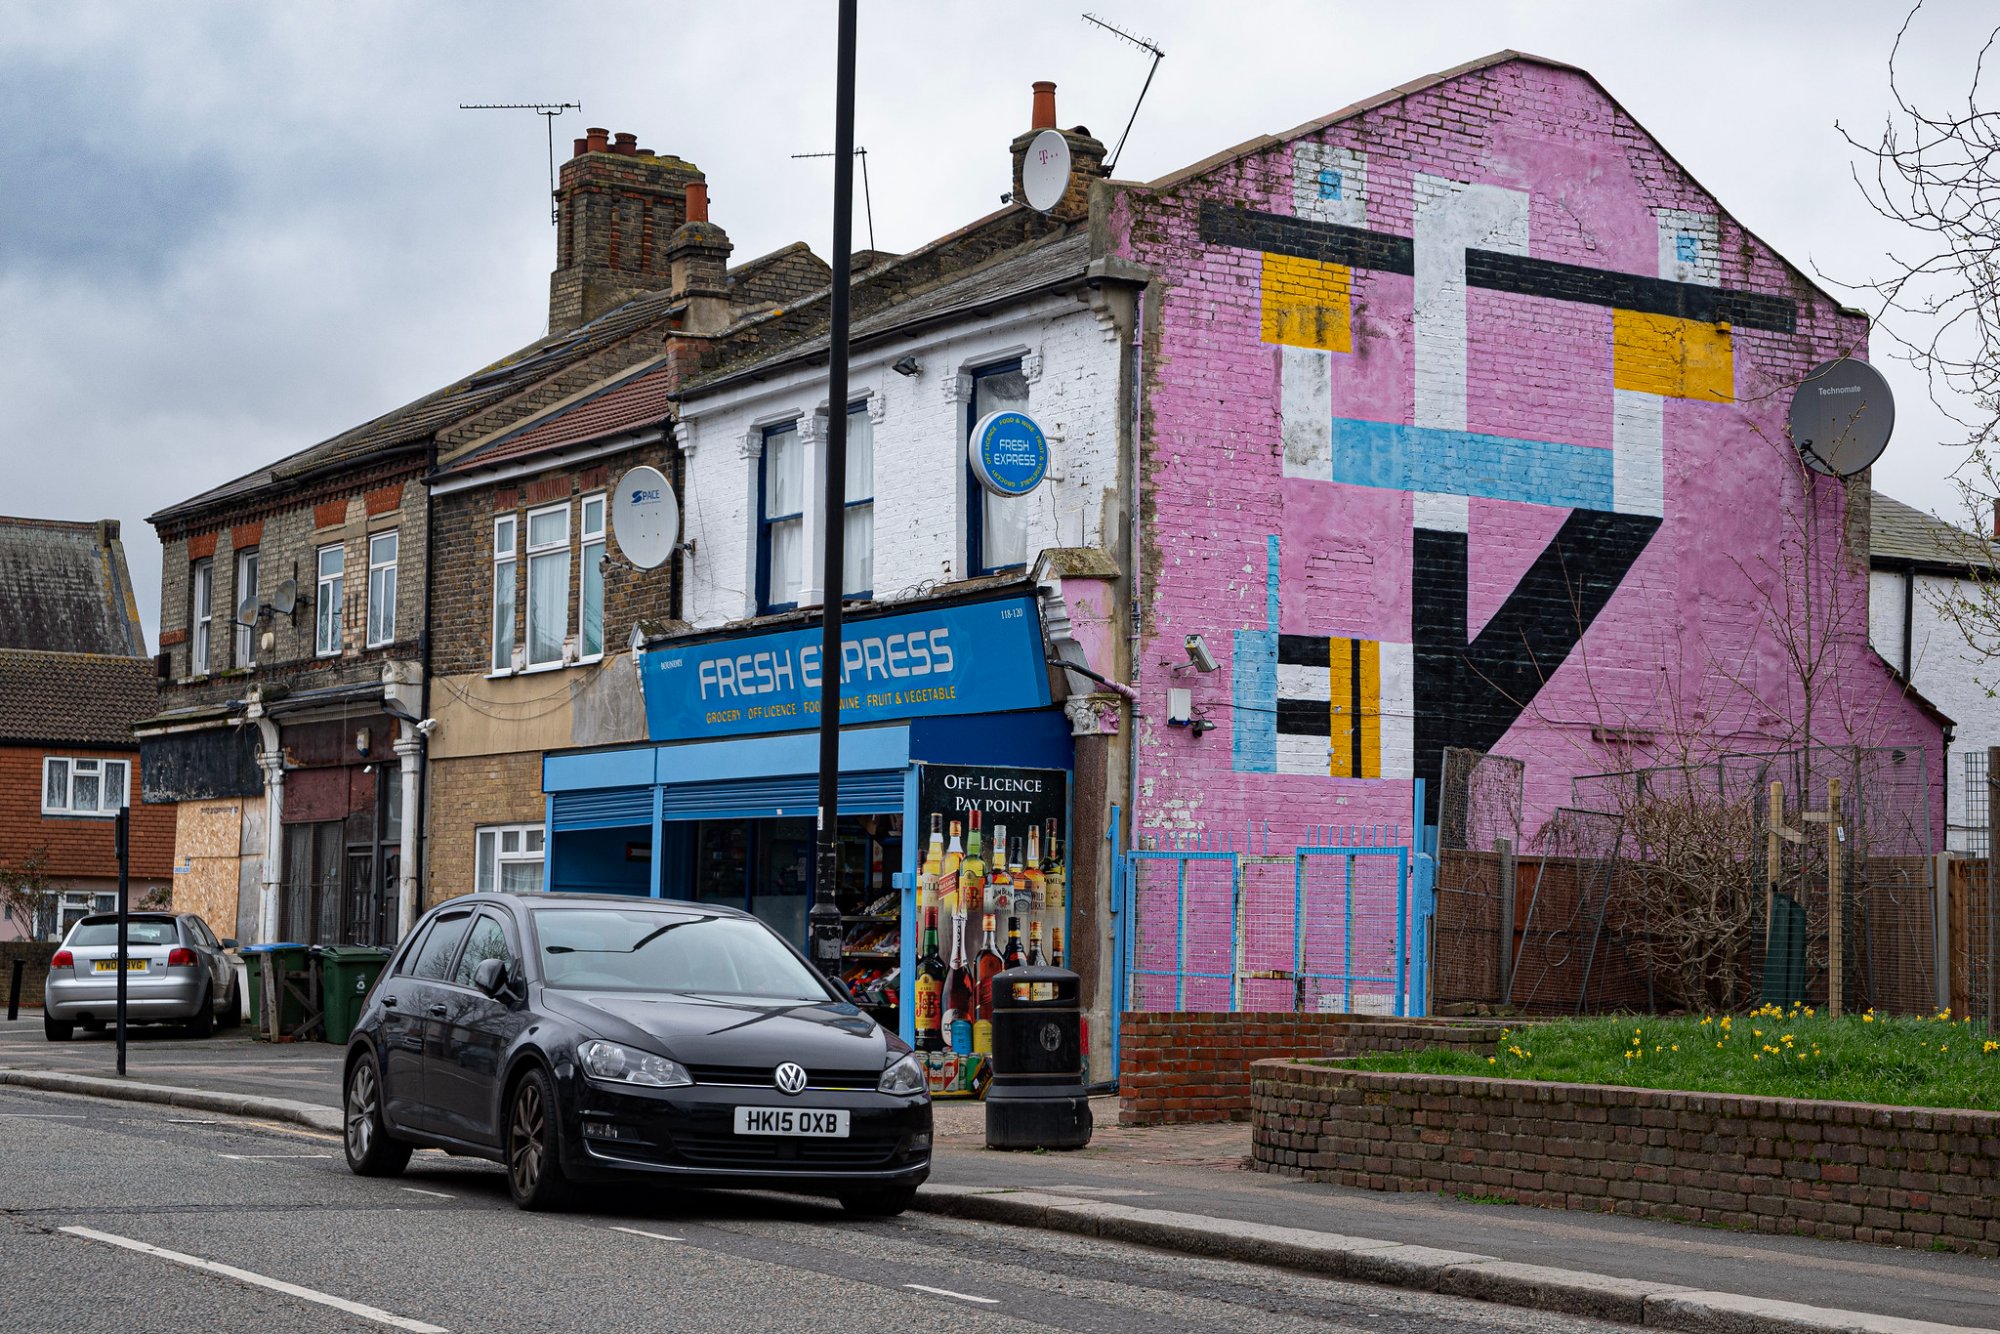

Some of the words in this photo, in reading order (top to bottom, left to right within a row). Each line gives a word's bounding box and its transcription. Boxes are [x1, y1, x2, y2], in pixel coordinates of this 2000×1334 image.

[1818, 385, 1861, 396] Technomate
[999, 417, 1014, 425] FOOD
[1021, 420, 1035, 432] WINE
[999, 439, 1029, 451] FRESH
[994, 453, 1036, 466] EXPRESS
[631, 489, 660, 504] SPACE
[699, 650, 794, 700] FRESH
[800, 628, 954, 688] EPRESS
[706, 709, 741, 724] GROCERY
[748, 707, 762, 720] OFF
[763, 703, 797, 718] LICENCE
[803, 701, 823, 714] FOO
[867, 693, 892, 707] FRUIT
[895, 692, 902, 705] &
[904, 686, 956, 703] VEGETABLE
[985, 800, 1032, 813] POINT
[747, 1111, 793, 1131] HK15
[799, 1113, 837, 1133] OXB
